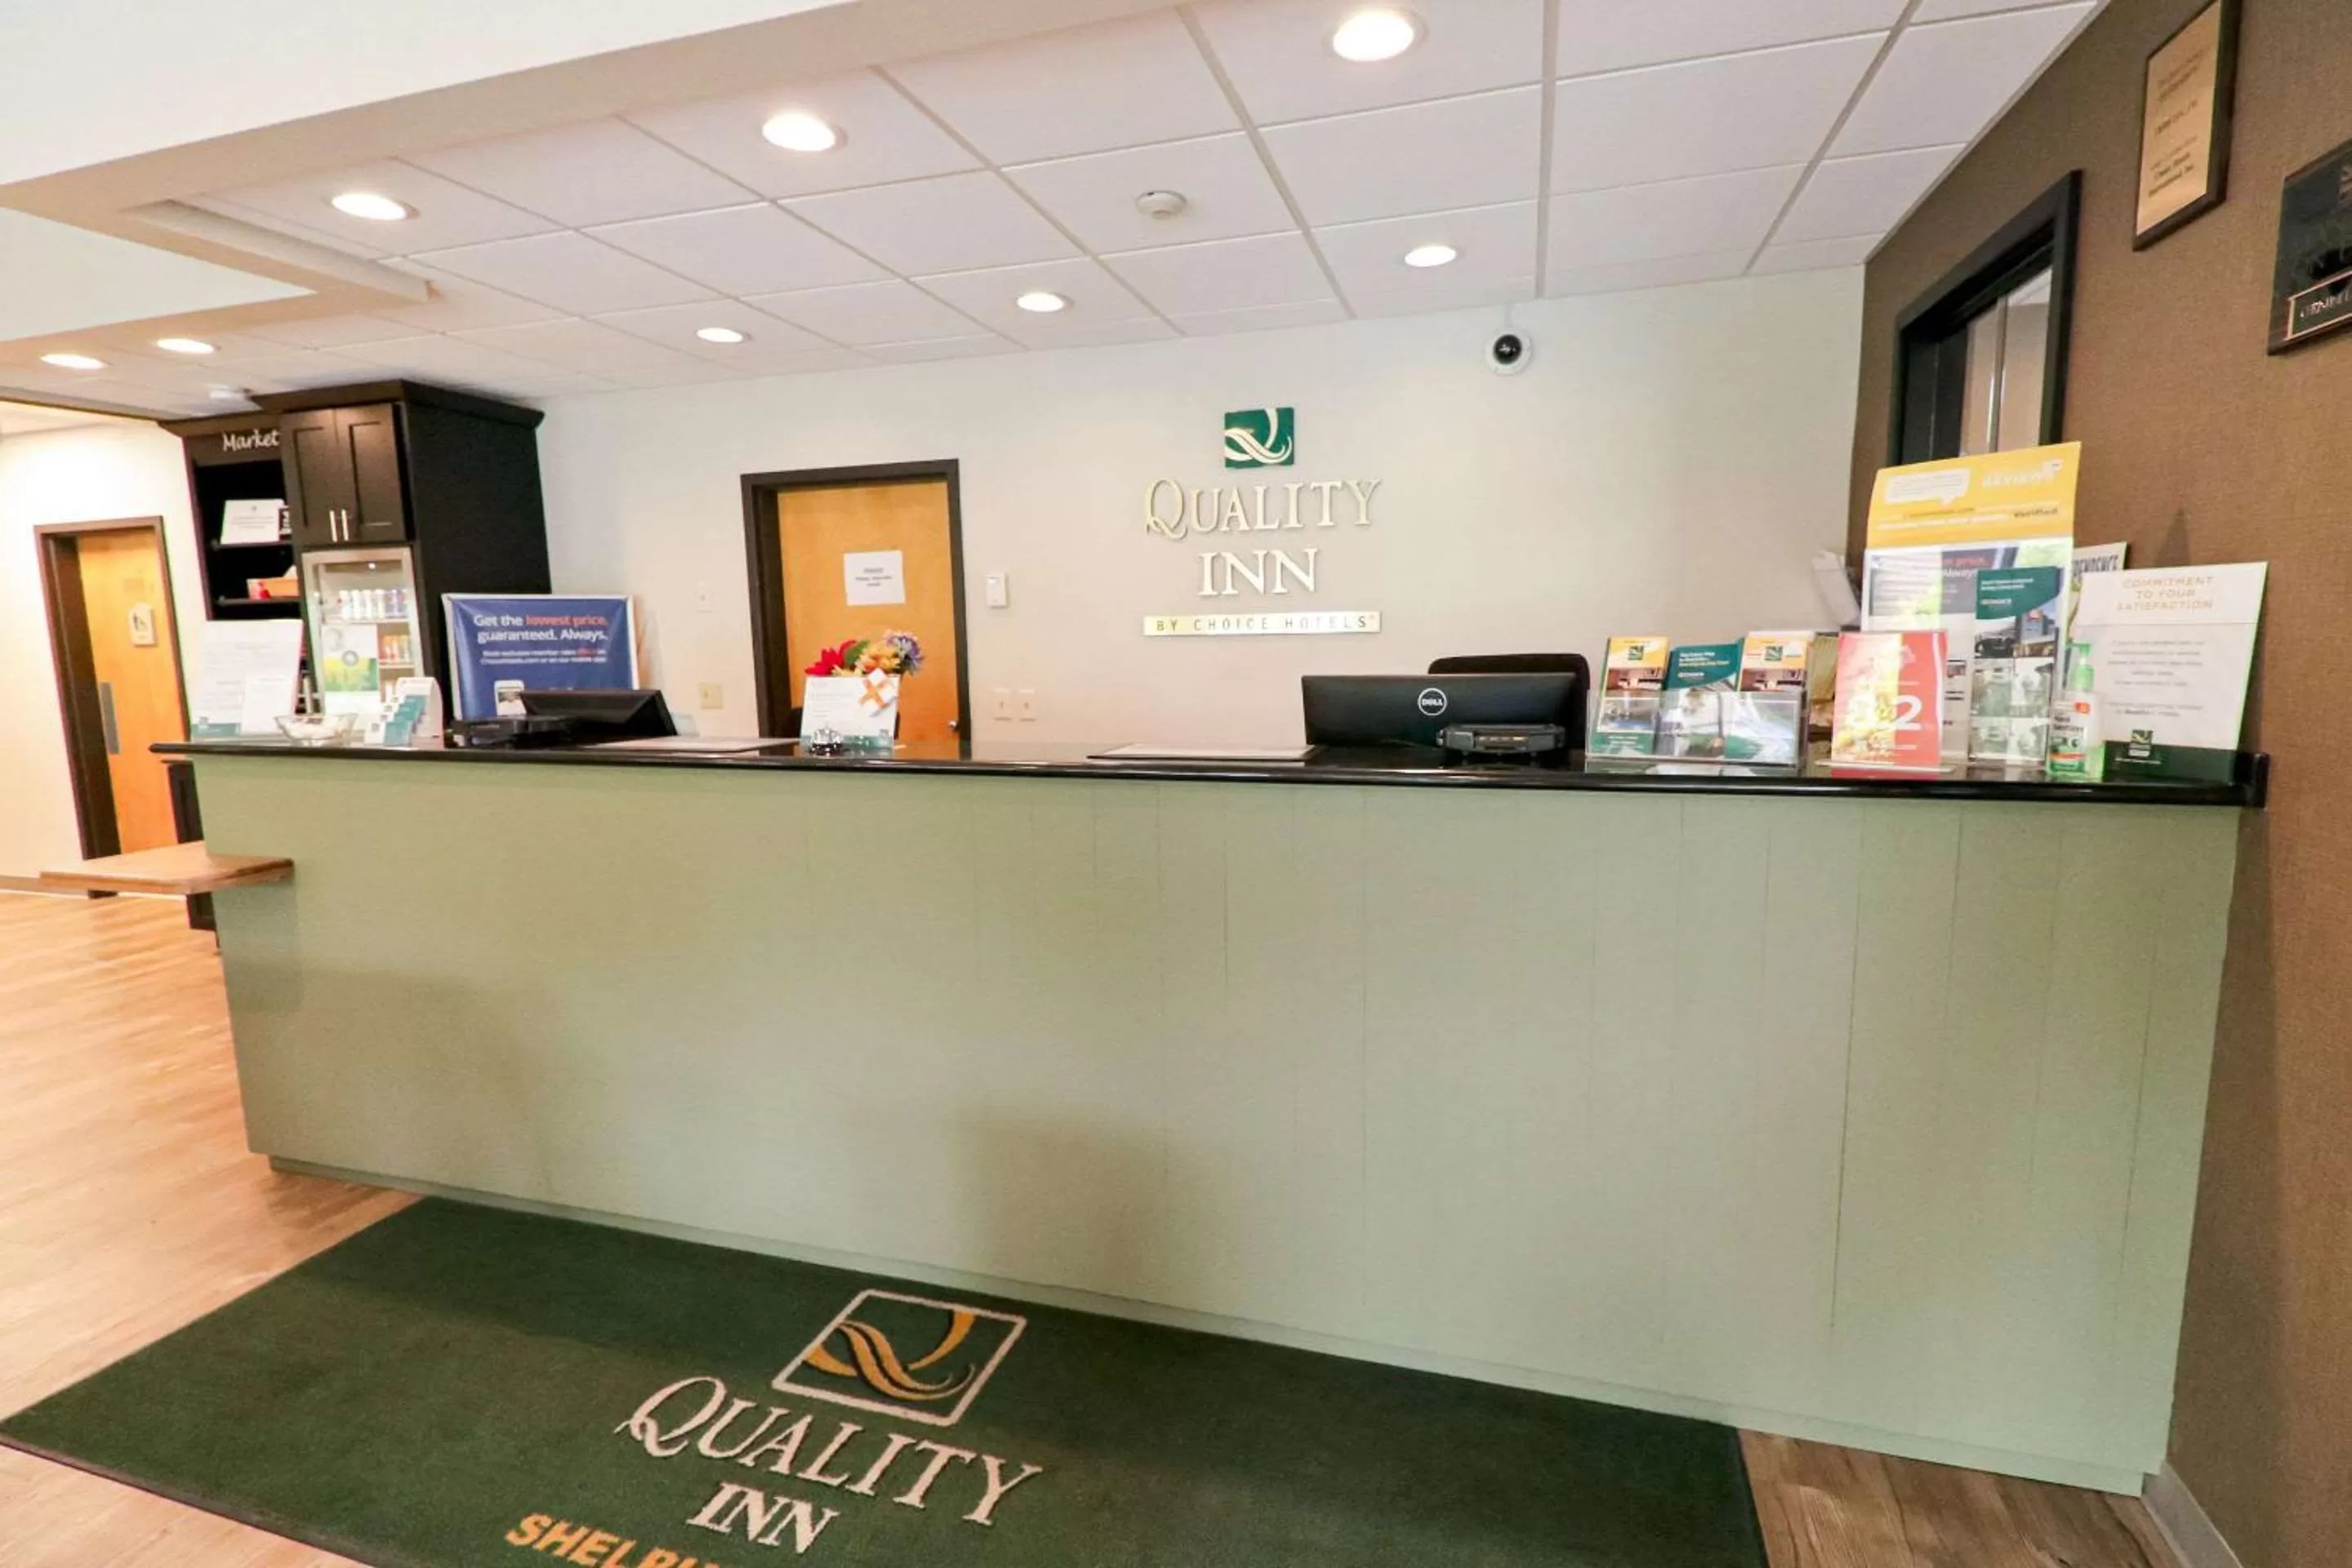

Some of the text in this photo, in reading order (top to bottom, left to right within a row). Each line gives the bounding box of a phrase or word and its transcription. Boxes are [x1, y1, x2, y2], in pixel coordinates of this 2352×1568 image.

[222, 428, 281, 452] Market
[1144, 478, 1382, 541] QUALITY
[1198, 546, 1319, 597] INN
[2123, 575, 2214, 588] COMMITMENT
[2136, 588, 2196, 599] TO YOUR
[2117, 599, 2214, 612] SATISFACTION
[474, 614, 498, 626] Get
[500, 613, 523, 626] the
[526, 614, 570, 626] lowest
[1156, 615, 1367, 631] BY CHOICE HOTELS
[477, 627, 608, 644] guaranteed. Always.
[1421, 698, 1444, 706] DELL
[612, 1375, 1043, 1526] QUALITY
[685, 1481, 840, 1554] INN
